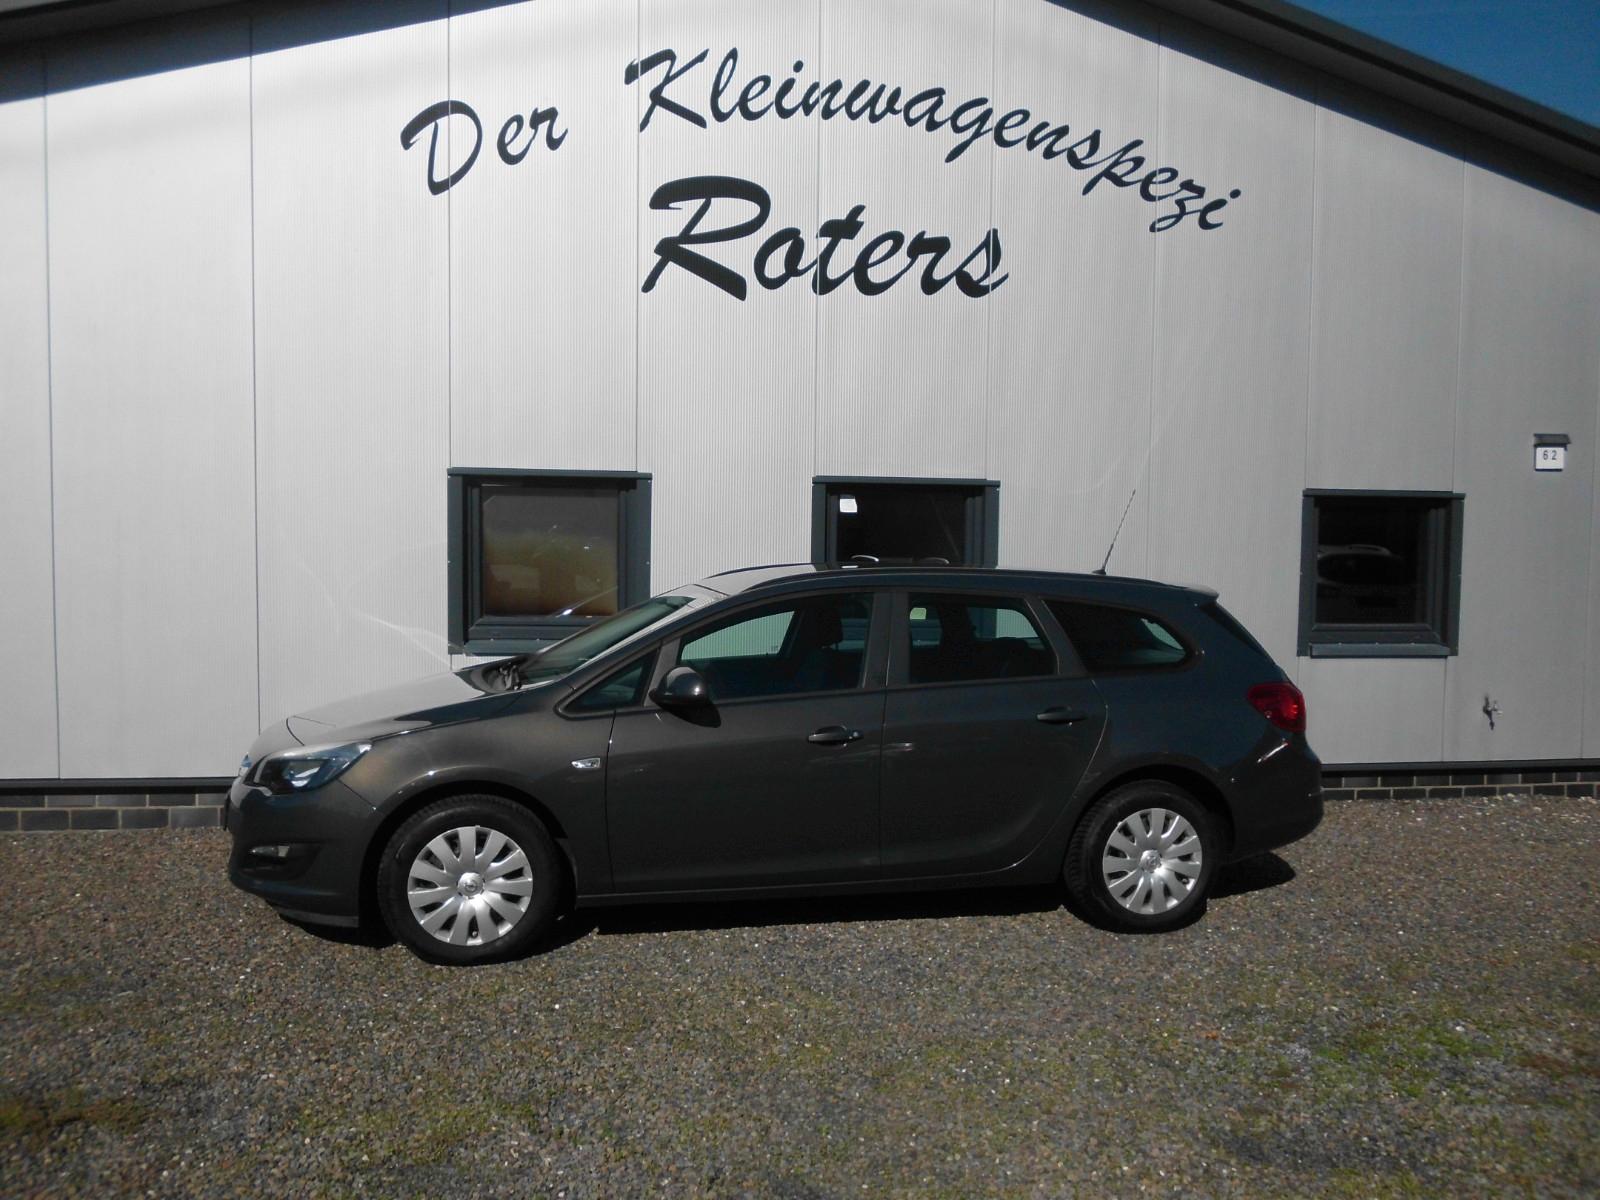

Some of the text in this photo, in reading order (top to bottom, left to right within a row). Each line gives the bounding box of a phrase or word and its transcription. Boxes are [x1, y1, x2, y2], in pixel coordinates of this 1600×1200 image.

[400, 46, 1242, 233] Der Kleinwagenspezi
[640, 175, 1009, 302] Roters
